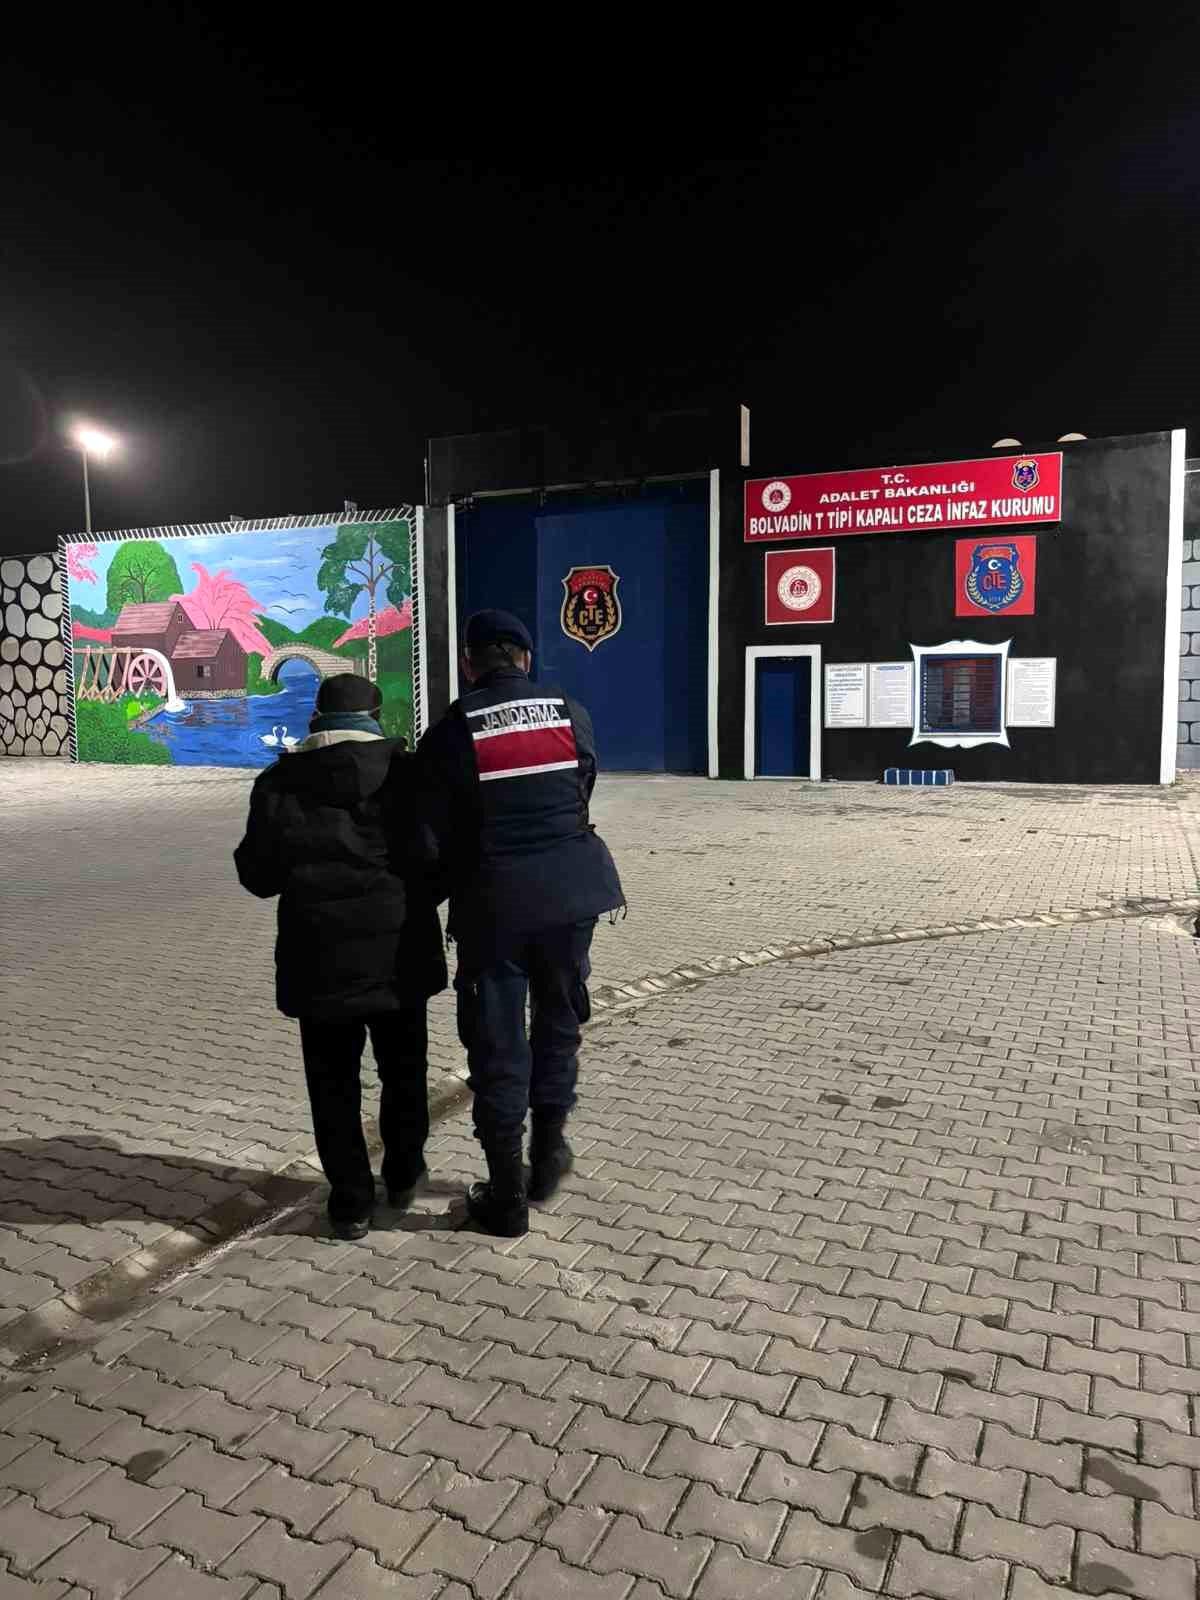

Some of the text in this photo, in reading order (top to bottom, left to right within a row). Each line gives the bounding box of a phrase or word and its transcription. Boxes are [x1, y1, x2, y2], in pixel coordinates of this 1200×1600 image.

[881, 473, 909, 485] T.C.
[819, 480, 976, 504] ADALET BAKANLIĞI
[750, 495, 1055, 535] BOLVADİN T TİPİ KAPALI CEZA İNFAZ KURUMU
[579, 605, 604, 625] CTE
[481, 704, 561, 730] JANDARMA
